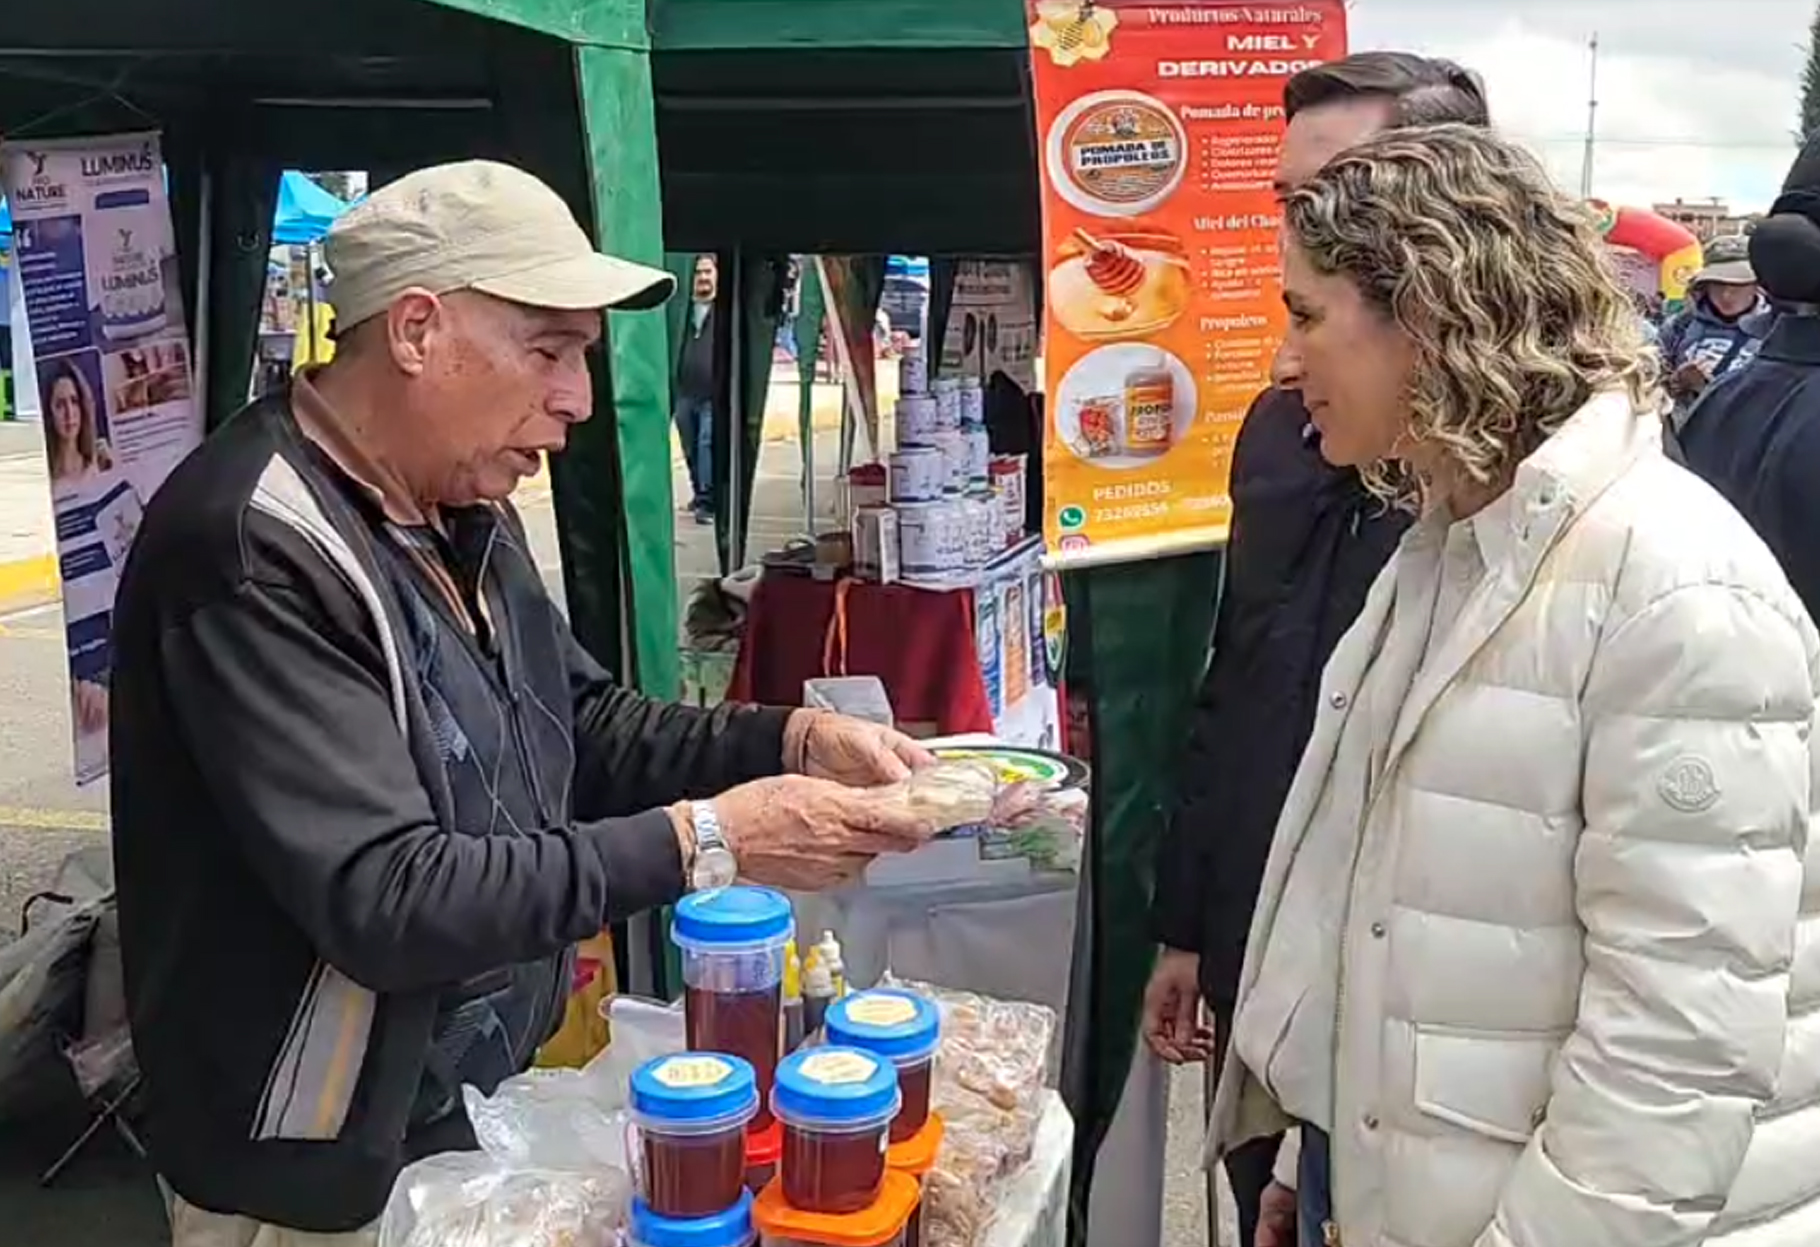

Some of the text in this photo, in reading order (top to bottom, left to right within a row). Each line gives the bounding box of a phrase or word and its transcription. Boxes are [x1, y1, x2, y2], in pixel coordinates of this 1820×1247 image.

[1148, 6, 1322, 24] Productos Naturales
[1227, 34, 1321, 51] MIEL Y
[1181, 104, 1240, 119] Pomada
[1243, 104, 1261, 118] de
[1081, 143, 1146, 155] POMADA
[16, 185, 67, 201] NATURE
[1193, 216, 1224, 231] Miel
[1226, 215, 1248, 230] del
[1093, 480, 1170, 501] PEDIDOS
